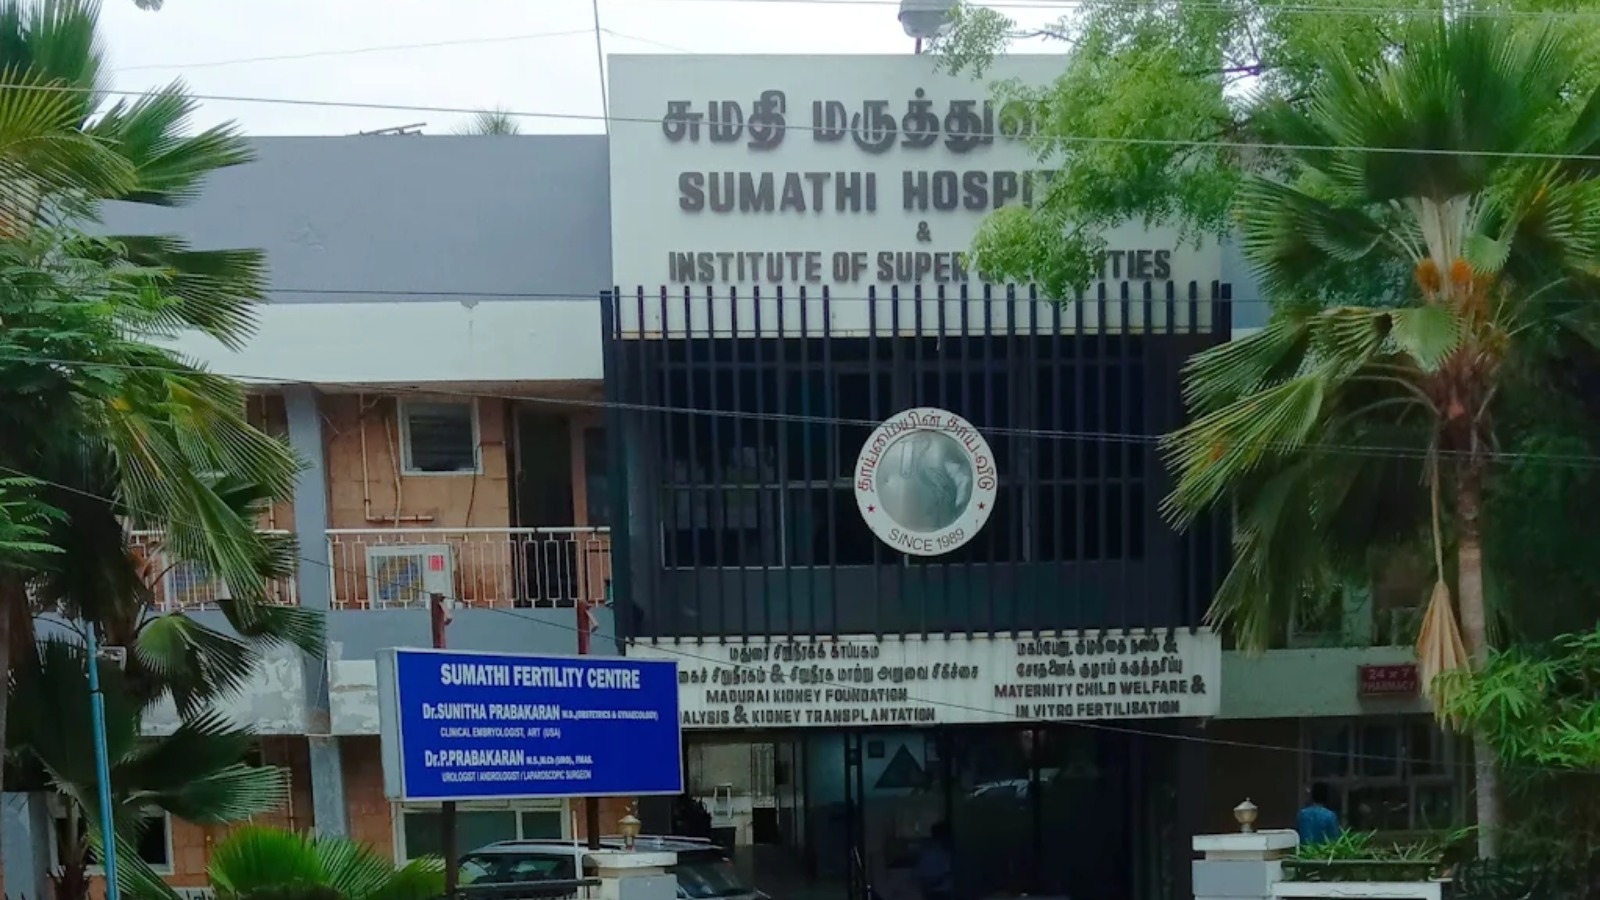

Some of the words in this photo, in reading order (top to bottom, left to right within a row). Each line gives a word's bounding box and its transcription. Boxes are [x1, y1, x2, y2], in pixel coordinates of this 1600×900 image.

[662, 89, 787, 150] சுமதி
[678, 170, 877, 214] SUMATHI
[915, 221, 933, 243] &
[668, 251, 822, 284] INSTITUTE
[832, 251, 868, 282] OF
[876, 251, 968, 283] SUPER
[888, 527, 934, 552] SINCE
[936, 527, 965, 551] 1989
[440, 663, 510, 687] SUMATHI
[513, 665, 584, 689] FERTILITY
[586, 667, 641, 690] CENTRE
[770, 663, 786, 684] &
[706, 689, 769, 704] MADURAI
[773, 689, 821, 703] KIDNEY
[825, 687, 908, 702] FOUNDATION
[994, 682, 1074, 698] MATERNITY
[1076, 682, 1117, 696] CHILD
[1119, 680, 1188, 695] WELFARE
[1190, 674, 1207, 695] &
[422, 702, 487, 721] Dr.SUNITHA
[489, 703, 560, 721] PRABAKARAN
[733, 704, 749, 724] &
[751, 708, 800, 723] KIDNEY
[805, 705, 936, 722] TRANSPLANTATION
[1015, 704, 1030, 718] IN
[1033, 704, 1074, 718] VITRO
[1077, 700, 1181, 716] FERTILISATION
[440, 726, 472, 738] CLINICAL
[527, 727, 541, 738] ART
[543, 727, 561, 740] (USA)
[425, 749, 525, 767] Dr.P.PRABAKARAN
[442, 771, 476, 782] UROLOGIST
